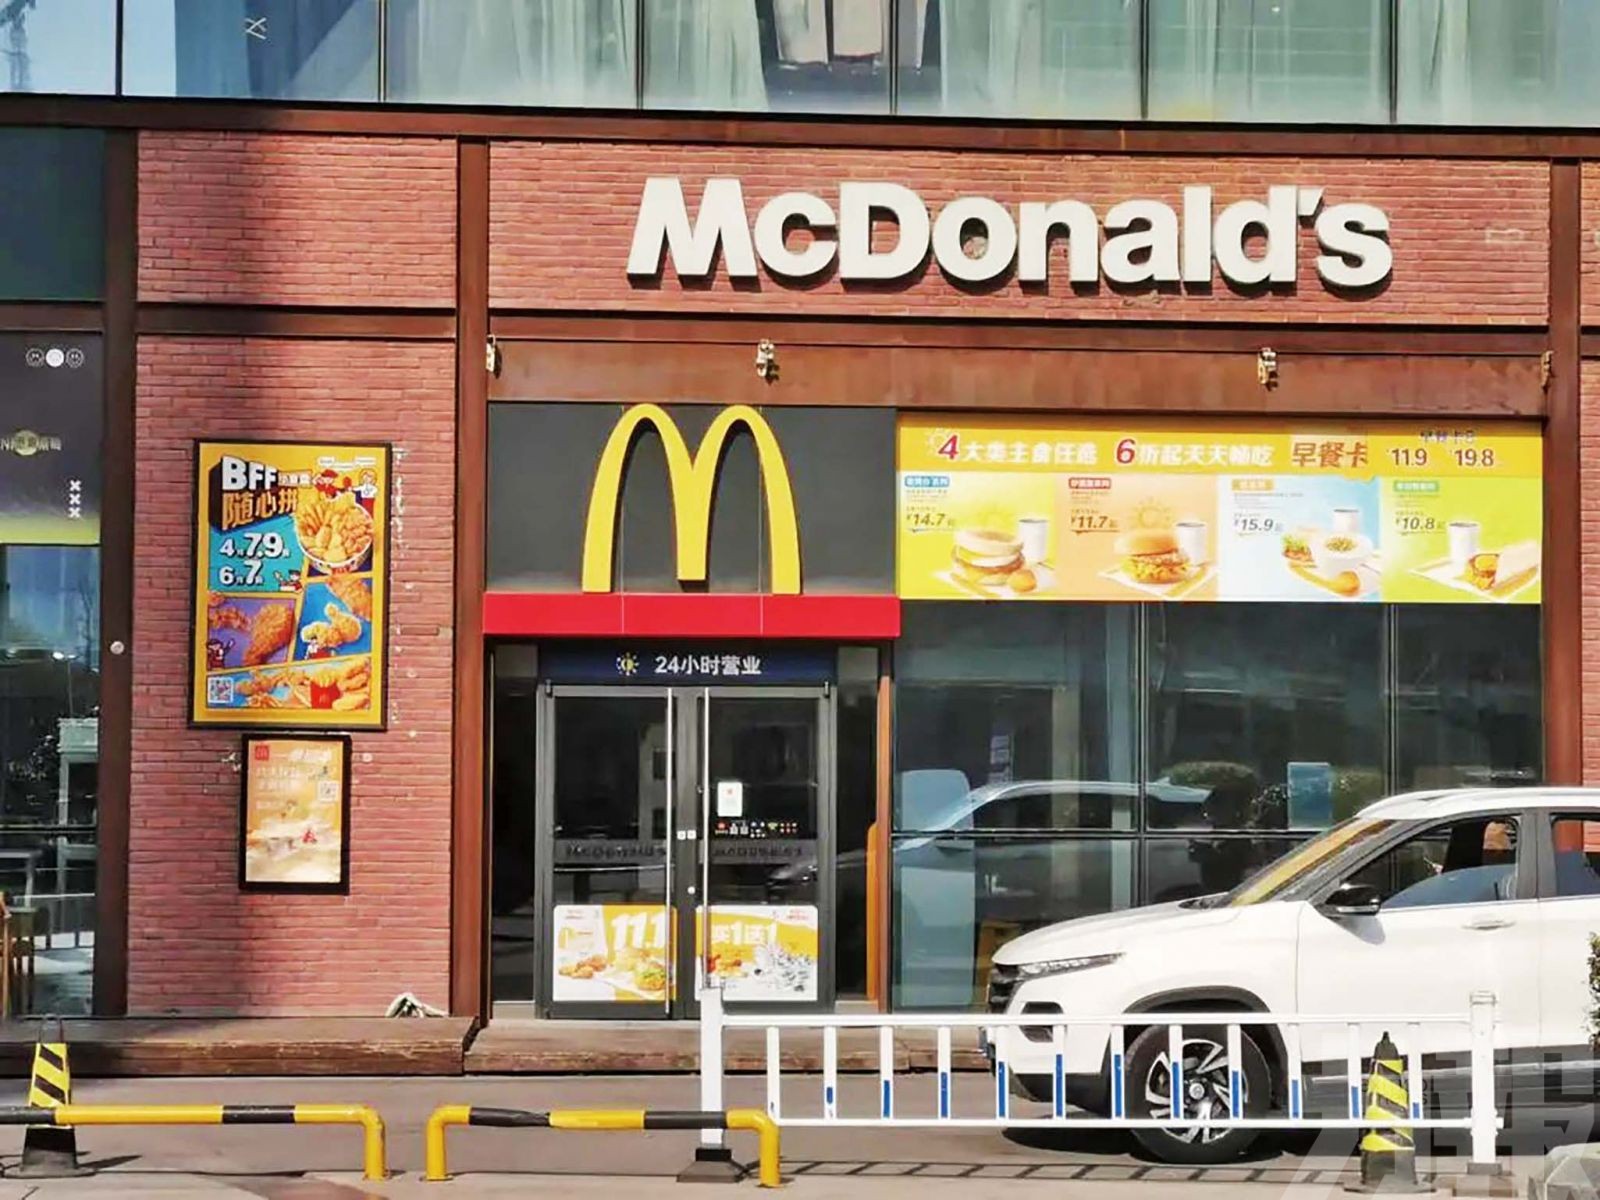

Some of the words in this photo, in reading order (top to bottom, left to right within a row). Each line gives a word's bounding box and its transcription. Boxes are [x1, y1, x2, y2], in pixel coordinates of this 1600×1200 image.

[627, 176, 1393, 286] McDonald's
[1292, 441, 1368, 468] 早餐卡
[221, 456, 278, 491] BFF
[222, 487, 298, 531] 随心拼
[654, 655, 763, 676] 24小时营业
